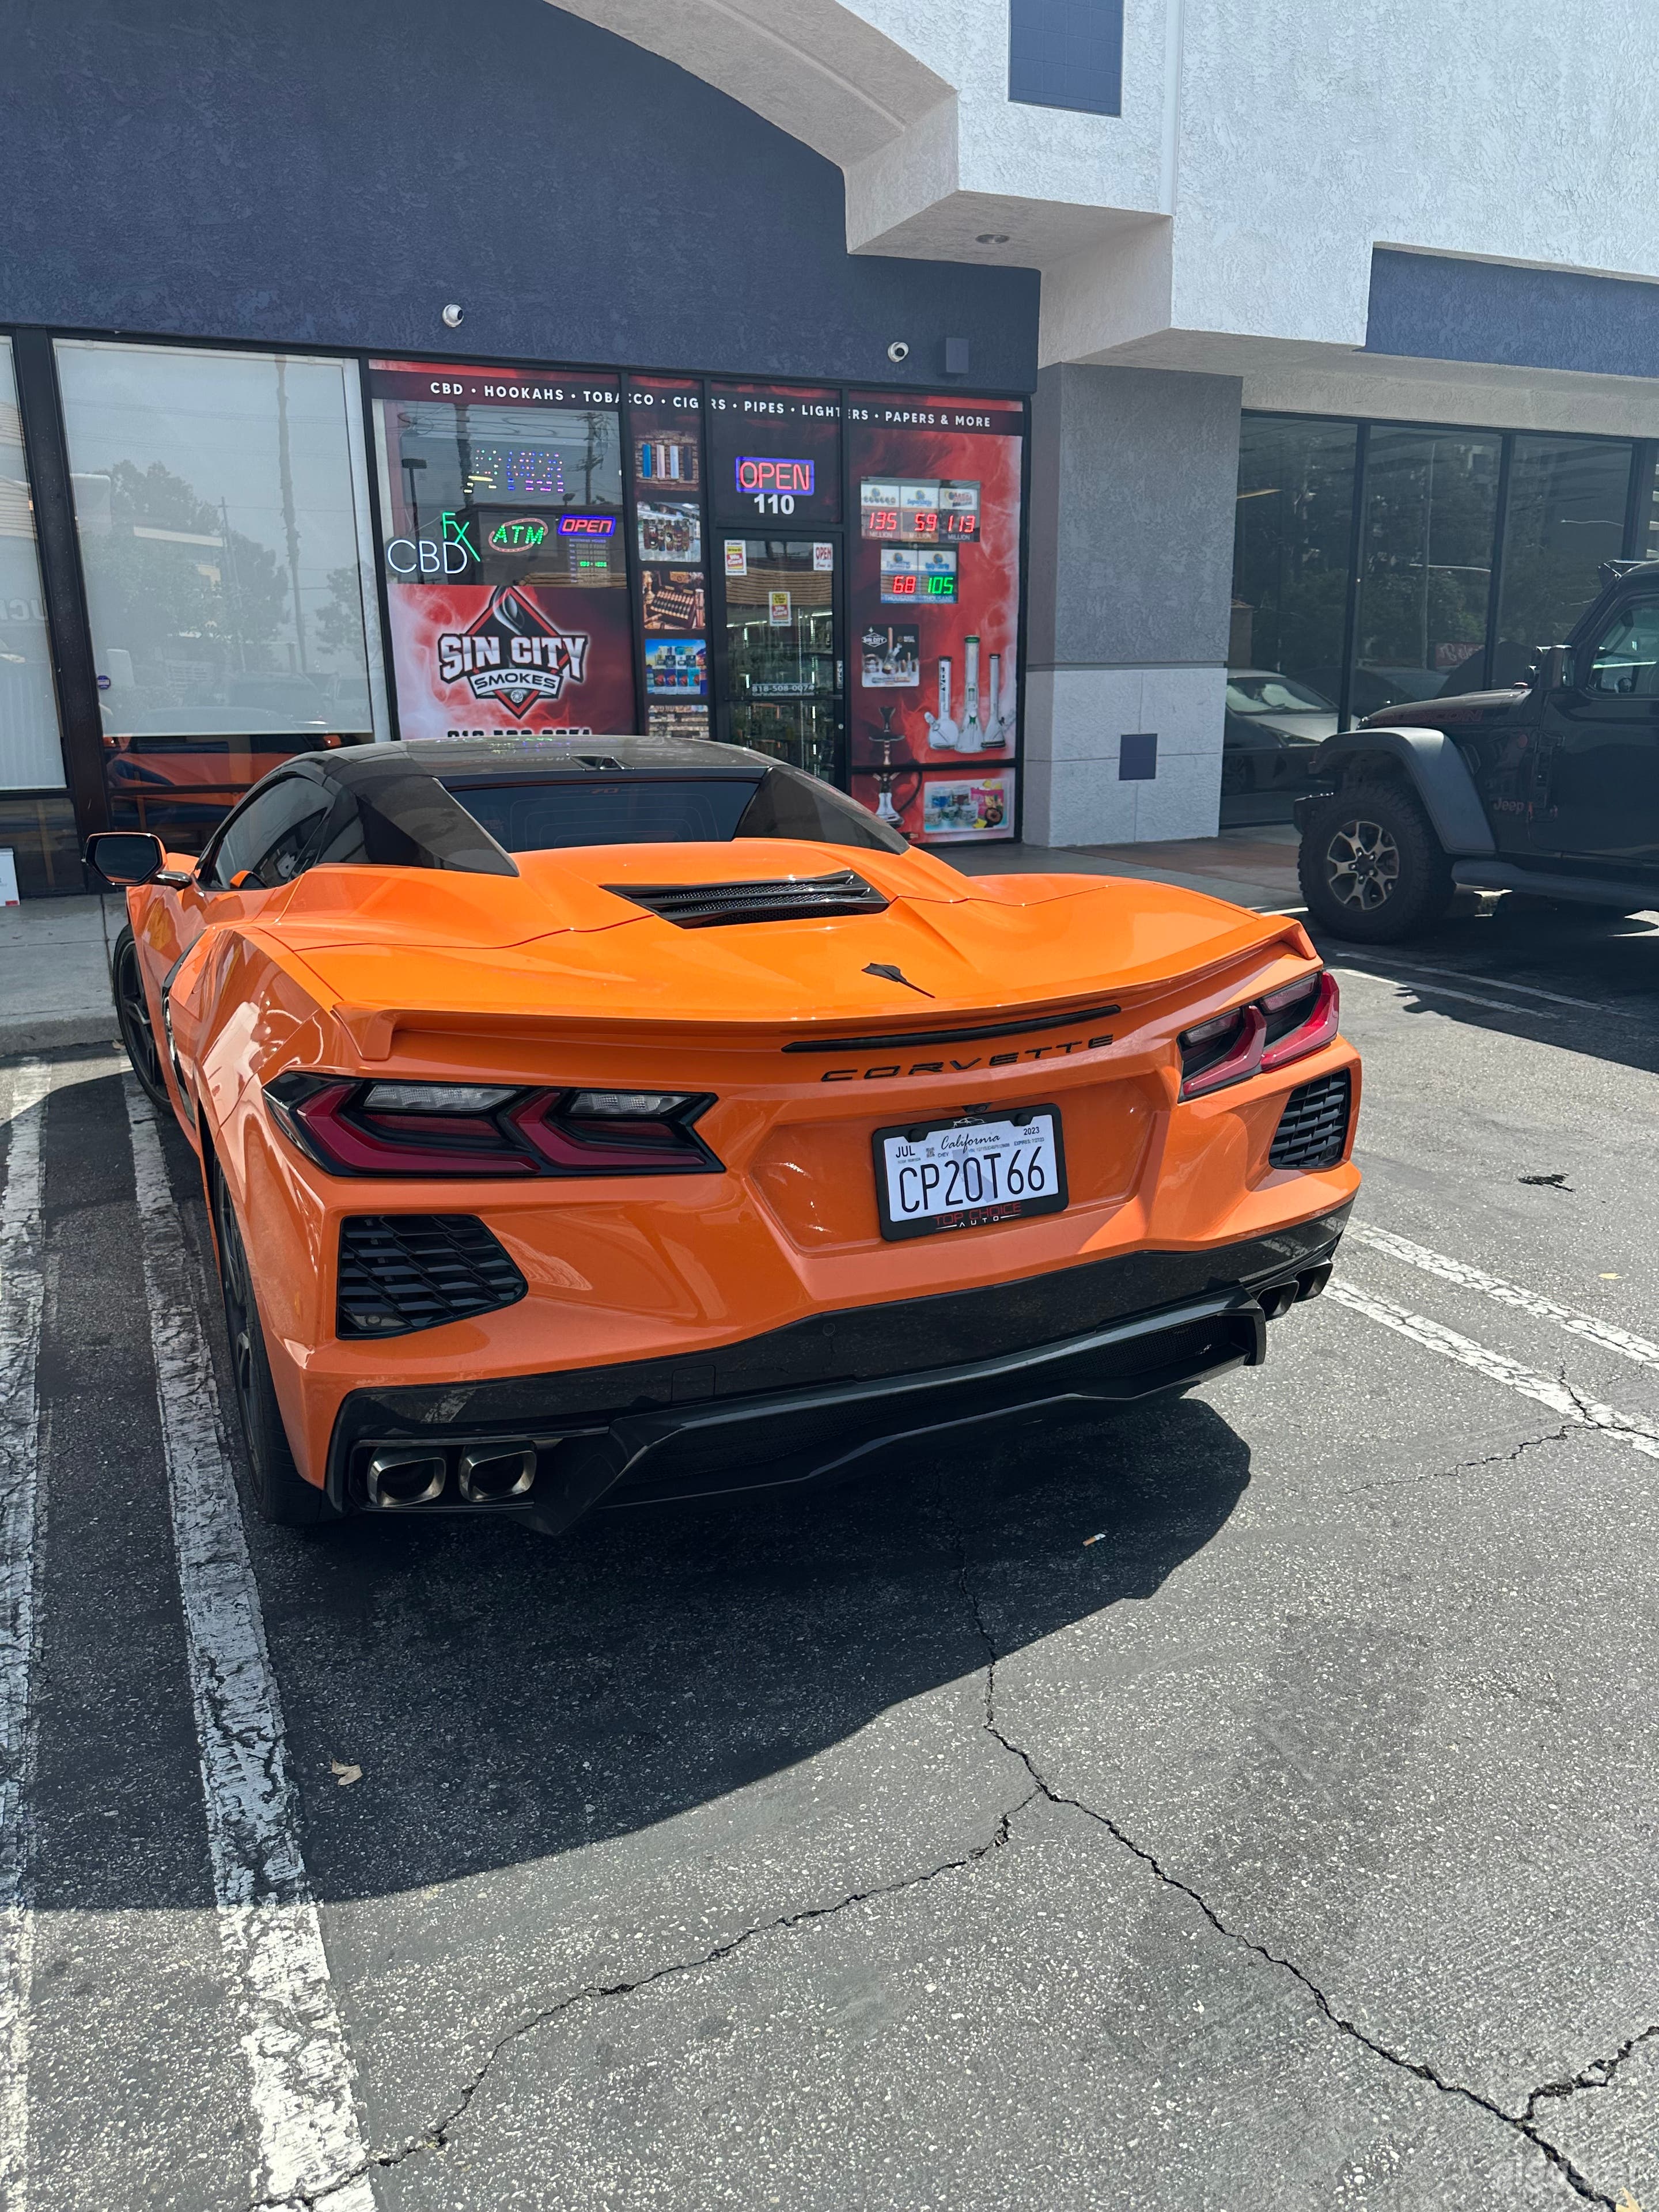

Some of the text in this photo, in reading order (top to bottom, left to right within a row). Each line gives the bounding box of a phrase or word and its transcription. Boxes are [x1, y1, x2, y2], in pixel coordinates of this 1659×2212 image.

[430, 382, 463, 395] CBD
[484, 385, 564, 400] HOOKAHS
[673, 397, 726, 410] CIGRS
[744, 401, 784, 414] PIPES
[802, 405, 869, 420] LIGHTRS
[885, 411, 934, 424] PAPERS
[941, 414, 949, 425] &
[955, 415, 991, 427] MORE
[740, 461, 809, 490] OPEN
[754, 494, 794, 514] 110
[562, 519, 612, 533] OPEN
[869, 511, 897, 530] 135
[914, 513, 937, 531] 59
[948, 515, 975, 533] 113
[493, 525, 544, 544] ATM
[387, 540, 467, 574] CBD
[816, 547, 832, 560] OPEN
[893, 576, 916, 594] 68
[928, 577, 953, 594] 105
[440, 635, 585, 680] SIN CITY
[474, 673, 556, 690] SMOKES
[1493, 797, 1525, 815] Jeep
[821, 1034, 1114, 1082] CORVETTE
[1023, 1126, 1040, 1135] 2023
[896, 1145, 916, 1158] JUL
[941, 1133, 1000, 1153] California
[899, 1146, 1045, 1213] CP20T66
[933, 1202, 1021, 1225] TOP CHOICE
[959, 1216, 1000, 1228] AUTO
